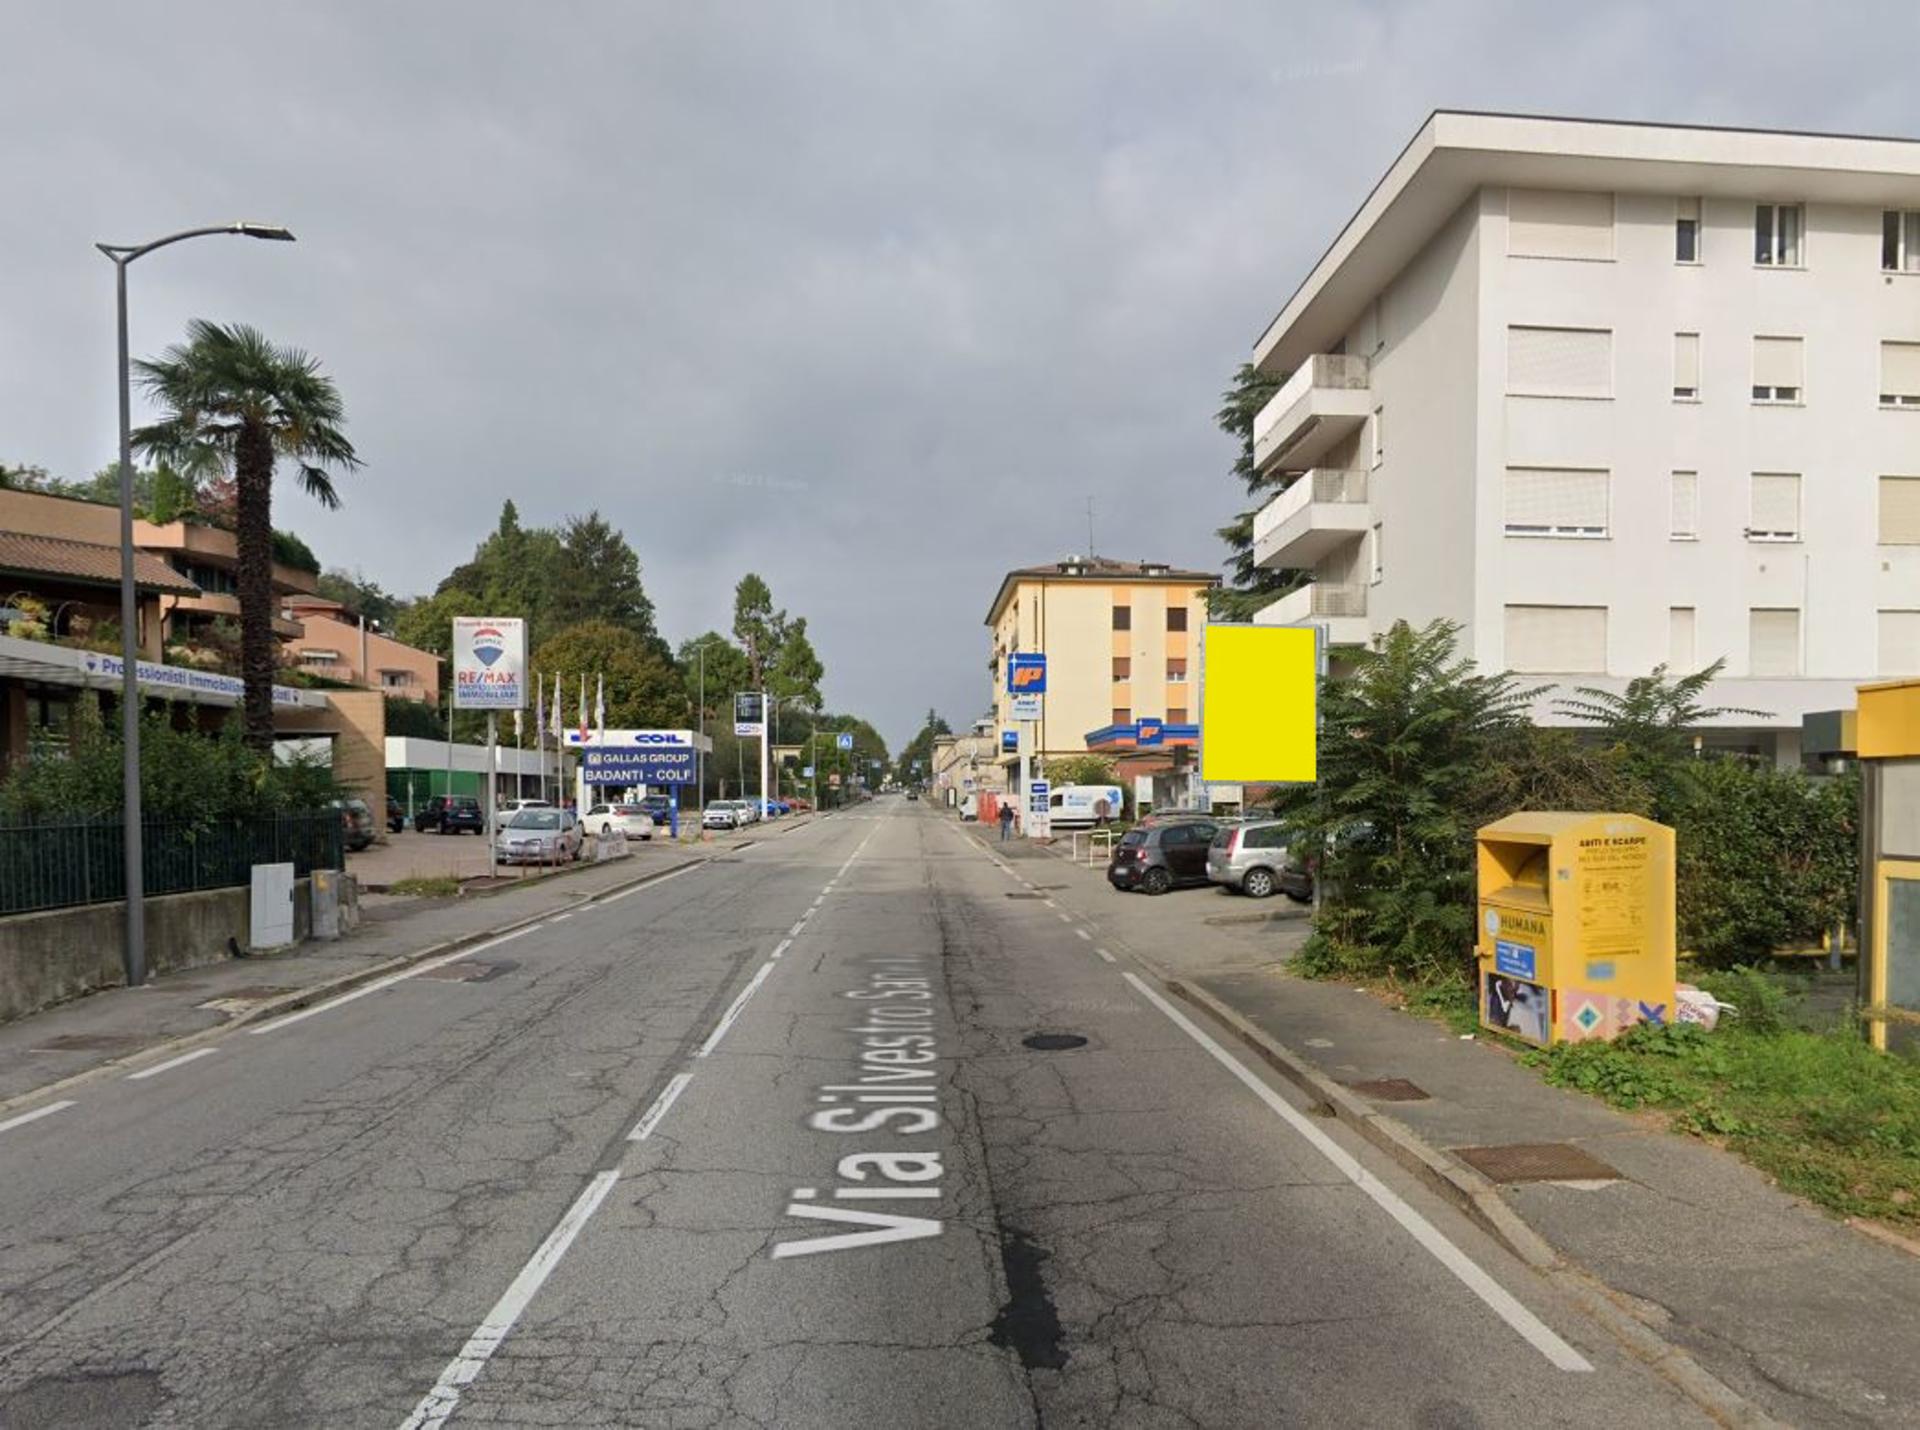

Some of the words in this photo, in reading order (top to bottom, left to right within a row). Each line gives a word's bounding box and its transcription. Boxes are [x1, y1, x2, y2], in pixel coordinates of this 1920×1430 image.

[102, 658, 186, 685] Prossionisti
[458, 671, 516, 684] RE/MAX
[1013, 667, 1043, 686] IP
[603, 753, 647, 764] GALLAS
[649, 753, 690, 764] GROUP
[585, 769, 644, 781] BADANTI
[656, 769, 692, 781] COLF
[1579, 838, 1602, 847] ABITI
[1613, 837, 1646, 845] SCARPE
[1500, 915, 1546, 935] HUMANA
